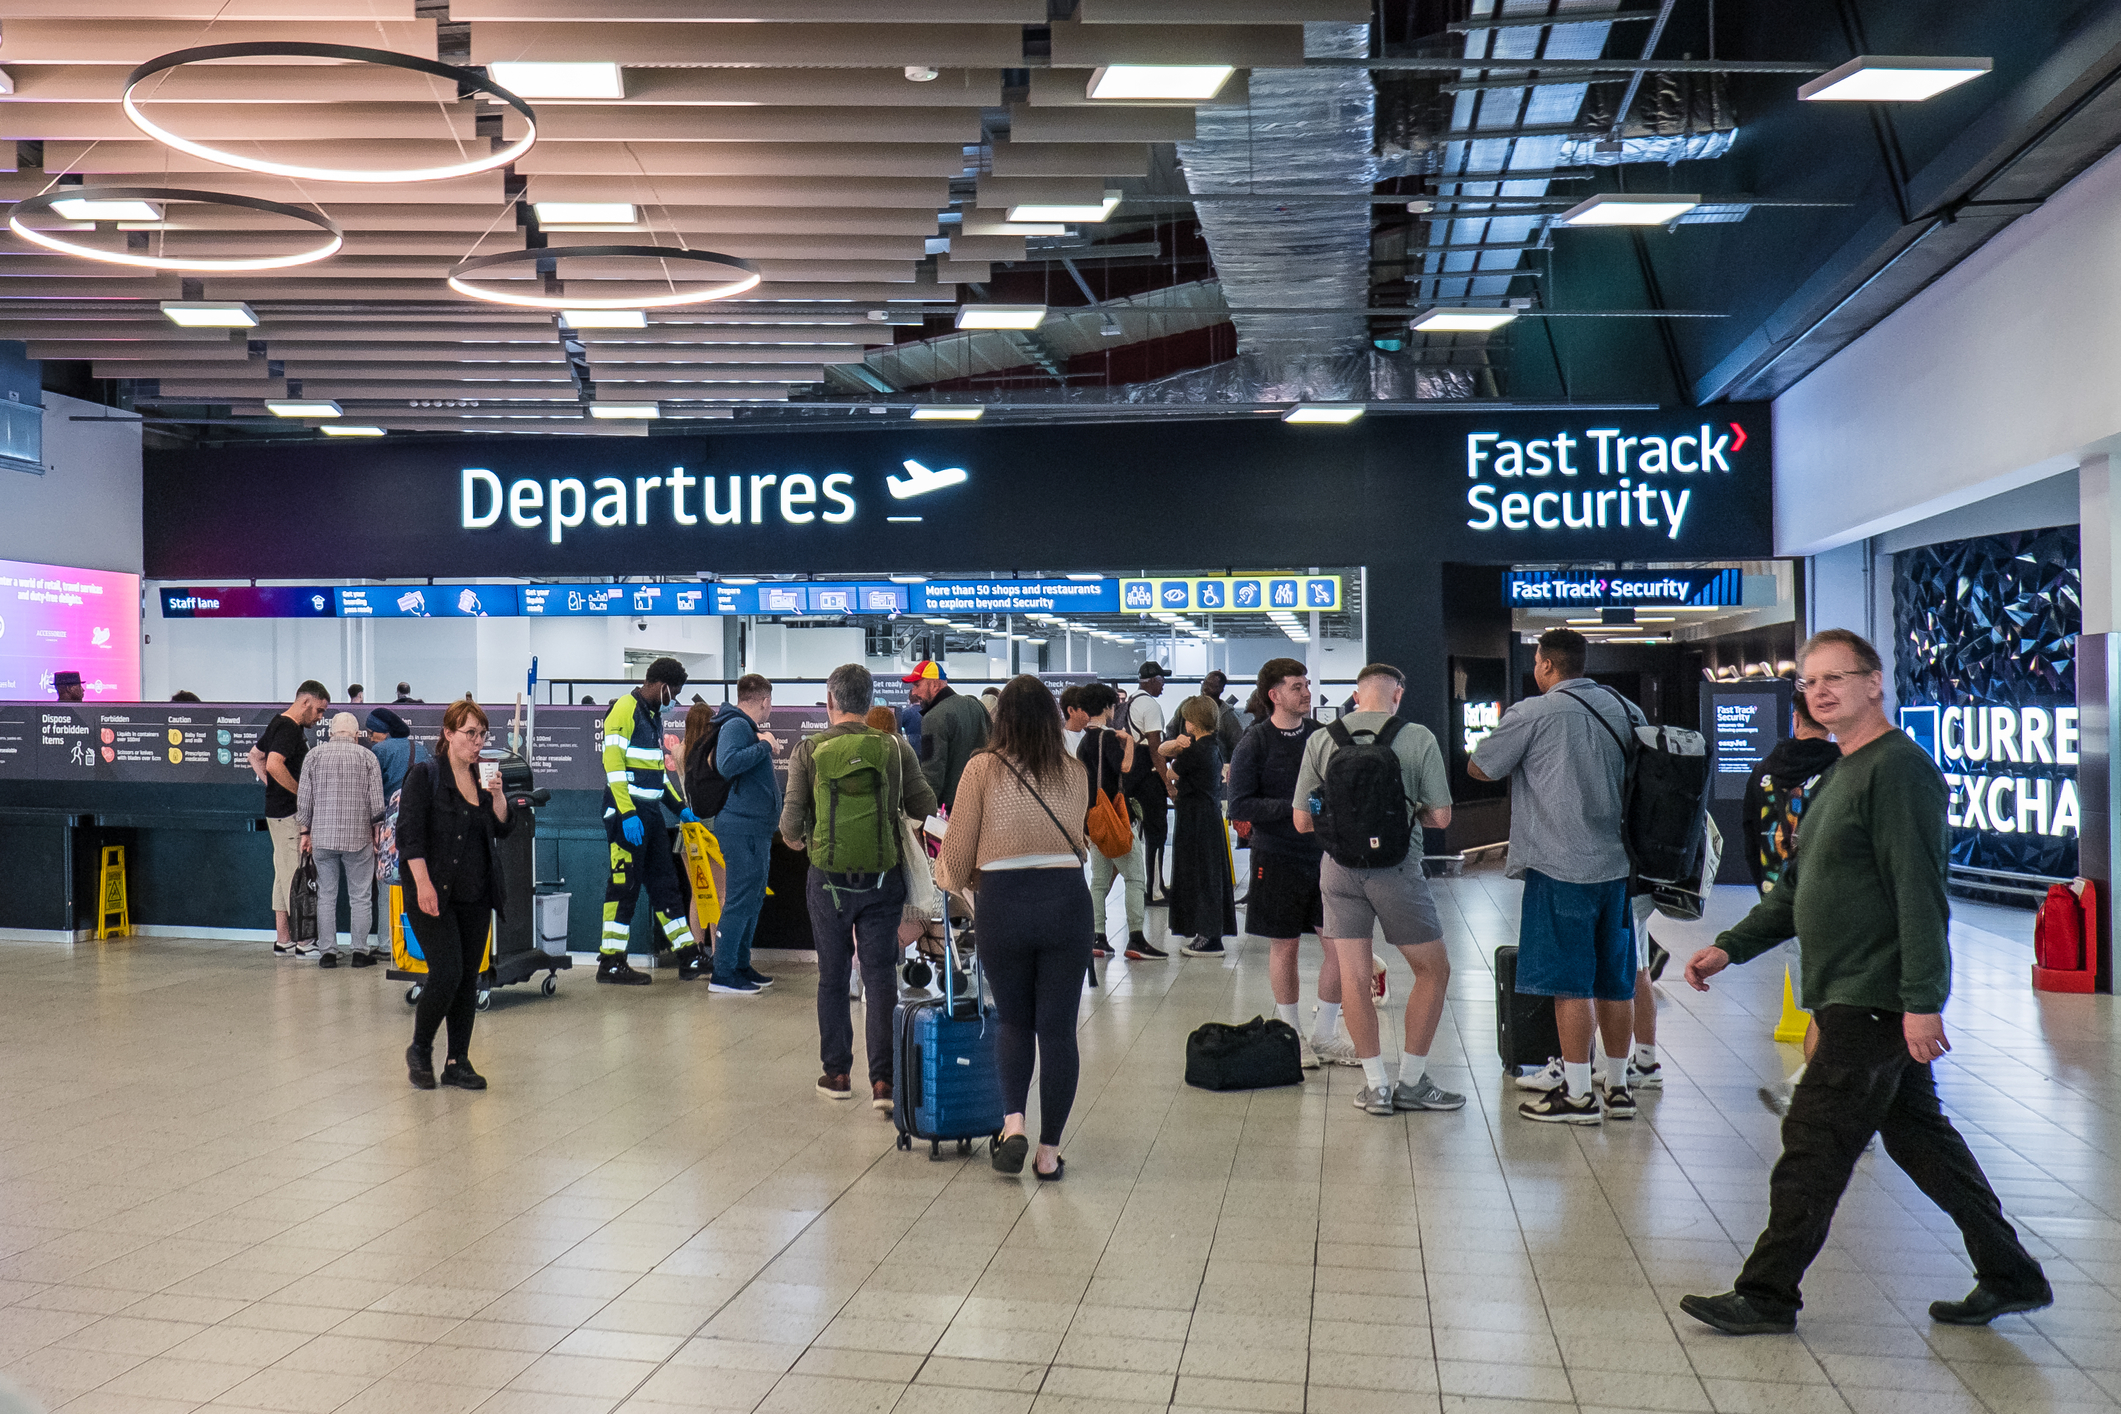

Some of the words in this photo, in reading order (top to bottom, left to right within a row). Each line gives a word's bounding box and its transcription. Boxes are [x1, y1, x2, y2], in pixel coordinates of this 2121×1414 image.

[1467, 431, 1578, 479] Fast
[1586, 424, 1730, 474] Track
[461, 466, 857, 544] Departures
[1467, 478, 1690, 540] Security
[19, 578, 36, 588] world
[37, 579, 44, 589] of
[62, 582, 80, 593] travel
[80, 583, 103, 594] services
[717, 587, 741, 595] Prepare
[925, 585, 951, 595] More
[951, 585, 975, 595] than
[977, 585, 990, 595] 50
[991, 584, 1020, 597] shops
[1022, 584, 1041, 594] and
[1042, 584, 1102, 594] restaurants
[1511, 581, 1551, 598] Fast
[1552, 580, 1602, 598] Track
[1610, 579, 1690, 601] Security
[18, 590, 30, 600] and
[30, 590, 58, 604] duty-free
[169, 597, 196, 609] Staff
[197, 597, 220, 609] lane
[926, 599, 938, 608] to
[939, 598, 974, 610] explore
[976, 598, 1010, 609] beyond
[1012, 598, 1053, 609] Security
[885, 680, 903, 689] ready
[1043, 680, 1064, 688] Check
[1464, 702, 1480, 728] Fast
[1480, 701, 1499, 728] Track
[1717, 705, 1734, 714] Fast
[1734, 705, 1756, 714] Track
[42, 714, 72, 724] Dispose
[1717, 713, 1751, 723] Security
[42, 724, 51, 734] of
[52, 724, 90, 735] forbidden
[801, 721, 828, 729] Allowed
[316, 727, 325, 737] of
[42, 735, 65, 745] items
[1718, 739, 1748, 747] easyJet
